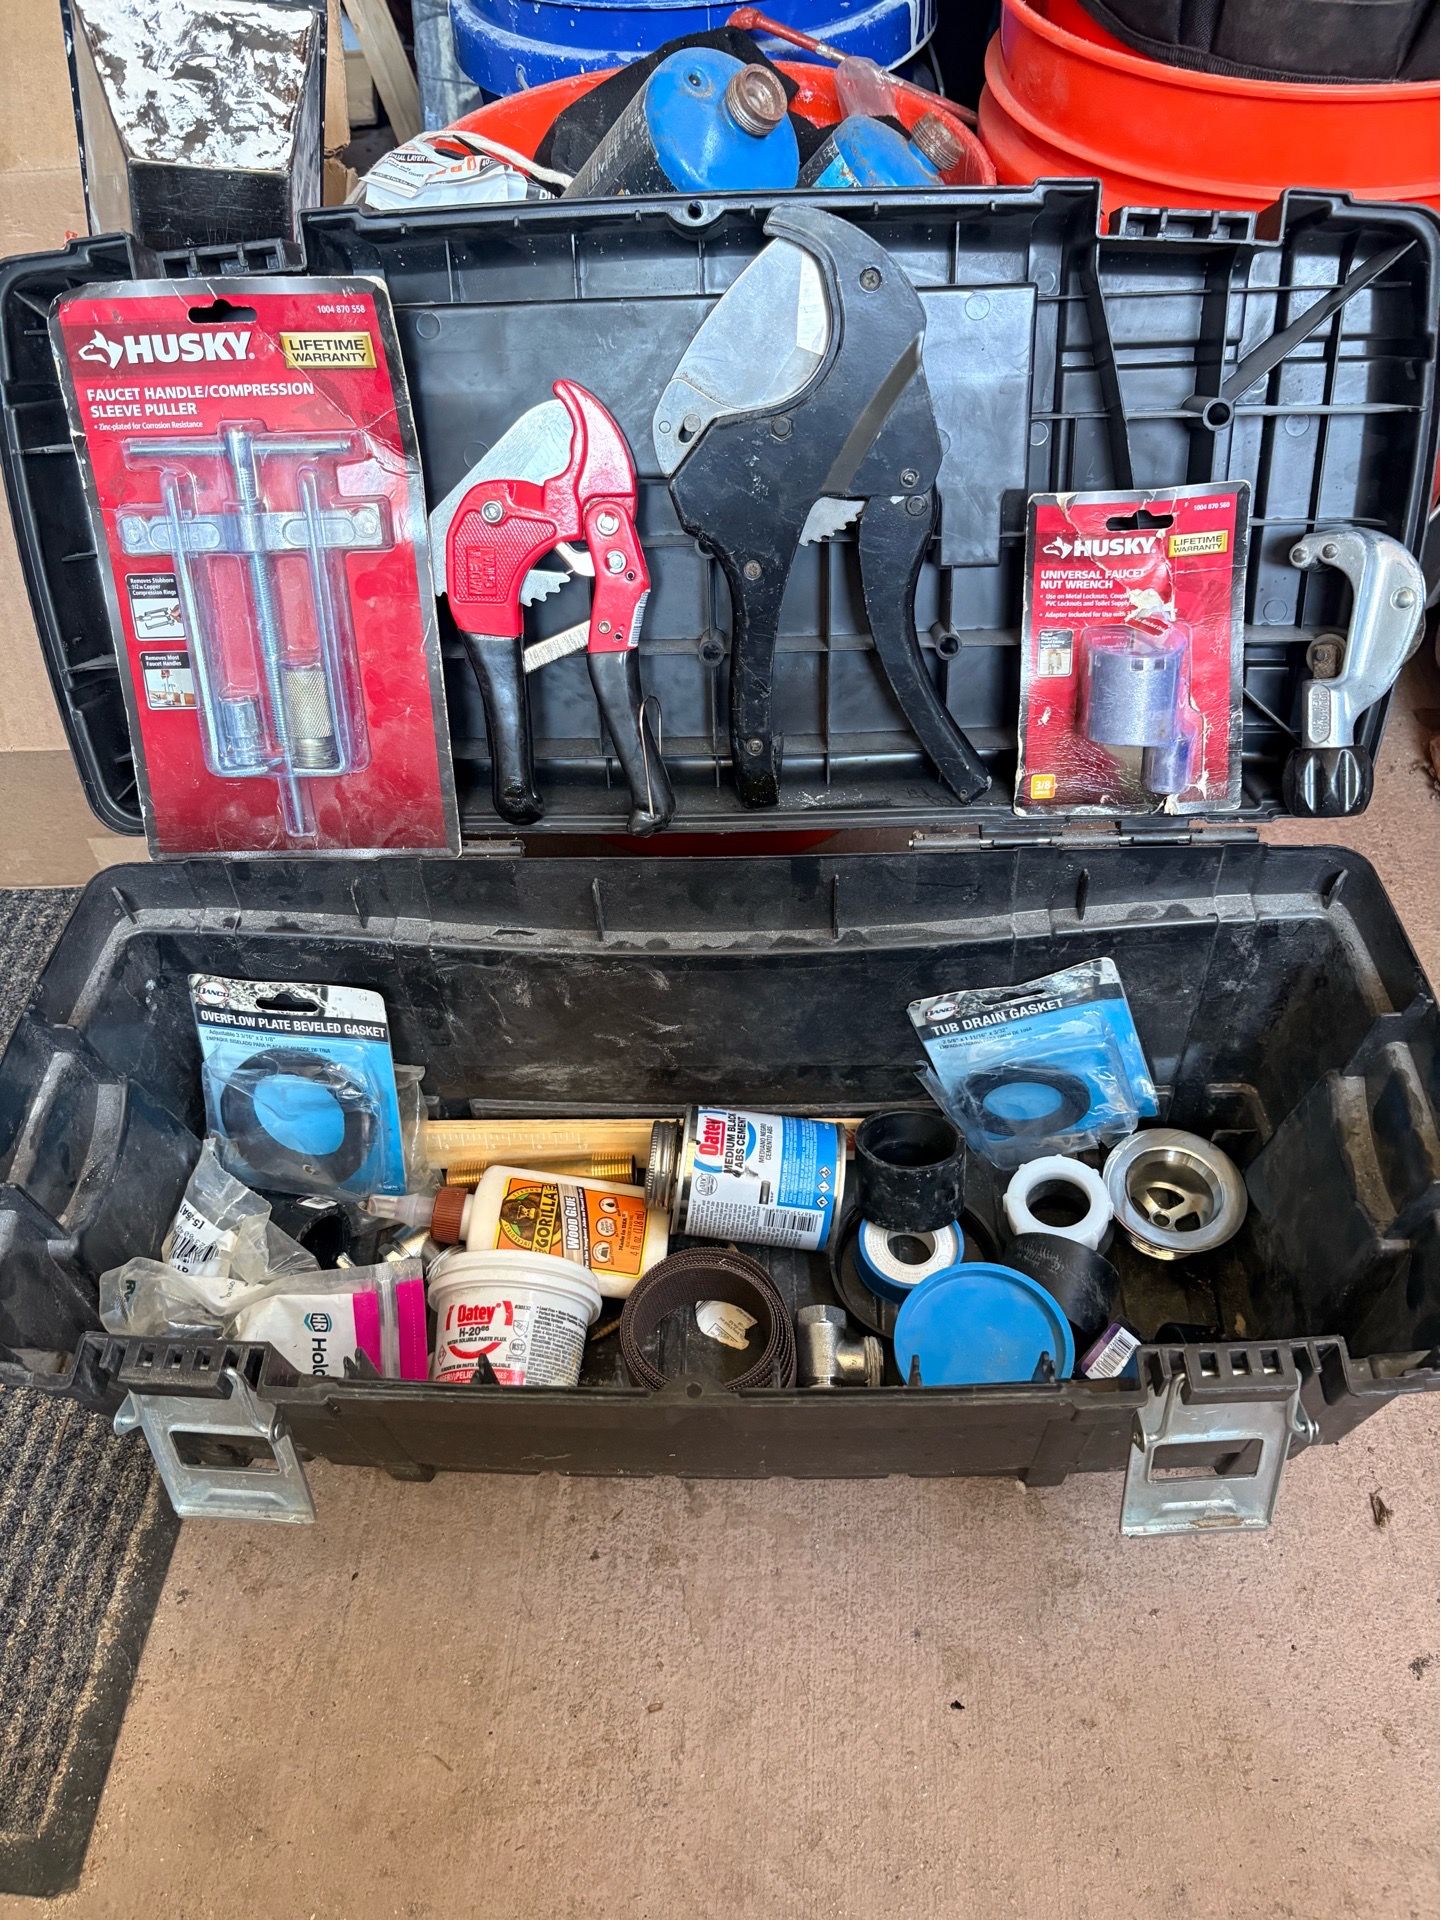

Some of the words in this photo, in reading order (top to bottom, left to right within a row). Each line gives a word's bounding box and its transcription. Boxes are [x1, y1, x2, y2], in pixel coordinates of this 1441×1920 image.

[317, 305, 335, 314] 1004
[336, 304, 350, 314] 870
[351, 304, 366, 313] 558
[123, 331, 251, 364] HUSKY
[289, 339, 364, 352] LIFETIME
[292, 352, 369, 363] WARRANTY
[86, 387, 140, 402] FAUCET
[144, 382, 315, 401] HANDLE/COMPRESSION
[90, 403, 142, 418] SLEEVE
[145, 402, 197, 417] PULLER
[98, 421, 131, 432] Zinc-plated
[132, 421, 141, 430] for
[141, 420, 170, 431] Corrosion
[171, 420, 203, 430] Resistance
[1074, 537, 1155, 557] HUSKY
[1173, 535, 1222, 547] LIFETIME
[1173, 543, 1222, 554] WARRANTY
[1040, 580, 1063, 589] NUT
[1065, 580, 1113, 589] WRENCH
[1041, 570, 1102, 580] UNIVERSAL
[1105, 569, 1145, 579] FAUCET
[201, 1010, 256, 1028] OVERFLOW
[258, 1017, 291, 1031] PLATE
[293, 1021, 341, 1035] BEVELED
[344, 1024, 386, 1038] GASKET
[931, 1023, 959, 1037] TUB
[962, 1012, 1007, 1030] DRAIN
[1009, 998, 1064, 1020] GASKET
[727, 1112, 737, 1132] BLACK
[736, 1116, 747, 1147] CEMENT
[698, 1117, 726, 1156] Oatey
[723, 1132, 736, 1174] MEDIUM
[735, 1147, 745, 1170] ABS
[758, 1138, 766, 1163] MEDIANO
[565, 1196, 578, 1217] GLUE
[535, 1192, 558, 1249] GORILLA
[566, 1217, 580, 1250] WOOD
[457, 1303, 496, 1328] Oatey
